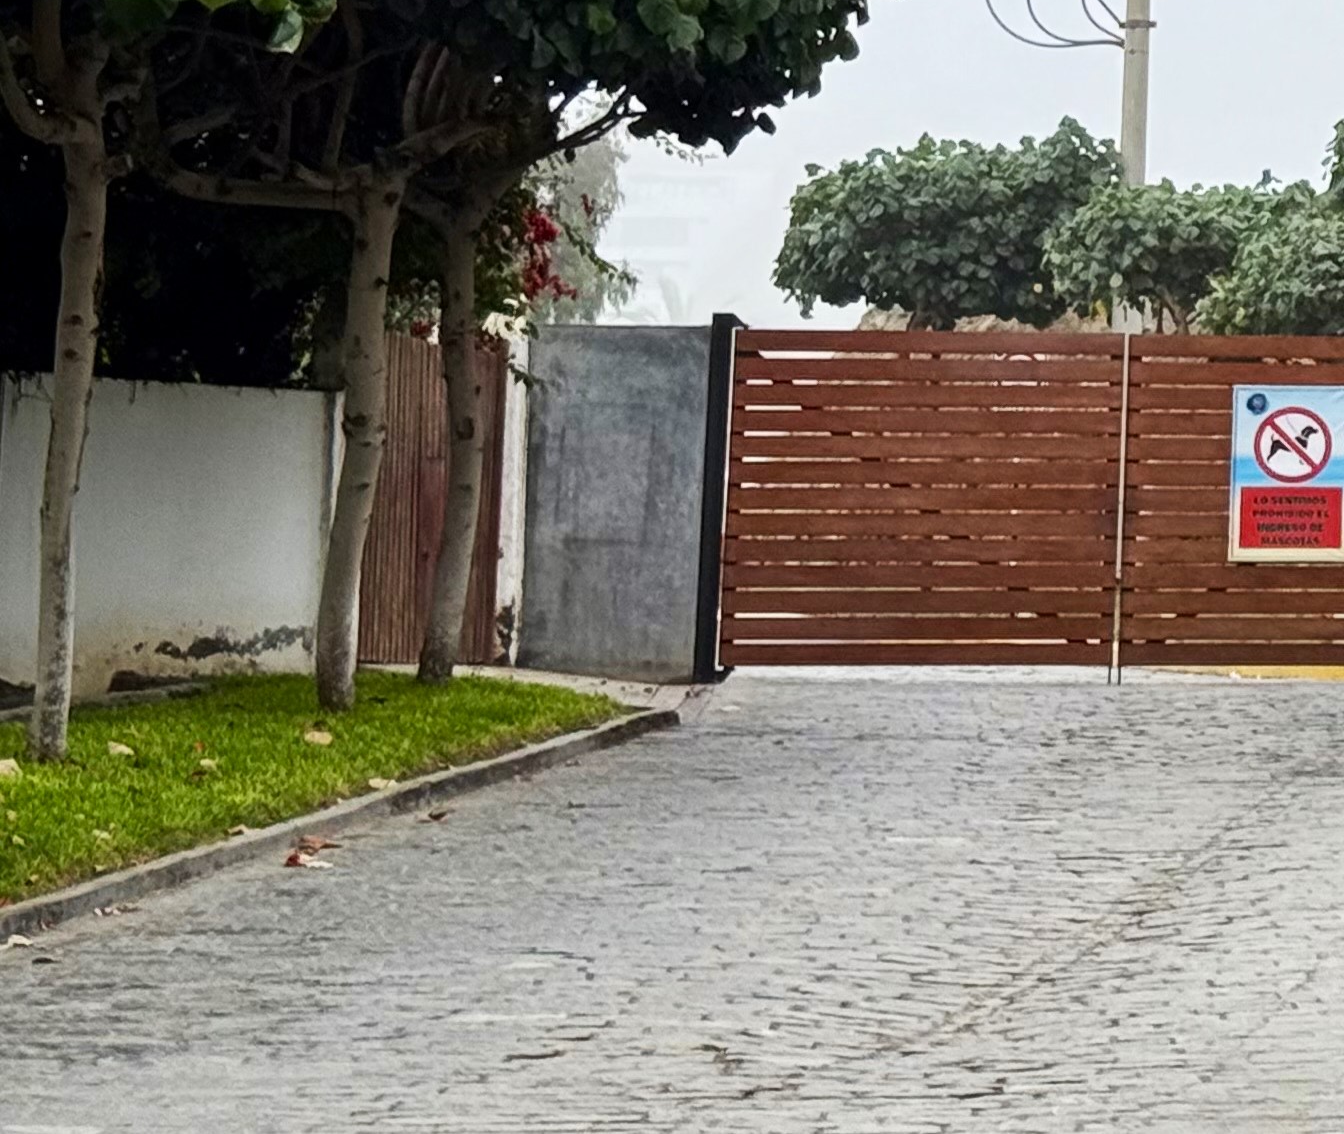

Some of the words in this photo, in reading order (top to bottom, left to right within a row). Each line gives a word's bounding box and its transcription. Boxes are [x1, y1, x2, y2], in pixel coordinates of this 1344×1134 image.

[1252, 510, 1314, 518] PROHIBIDO
[1257, 523, 1307, 532] INGRESO
[1260, 536, 1320, 546] MASCOTAS
